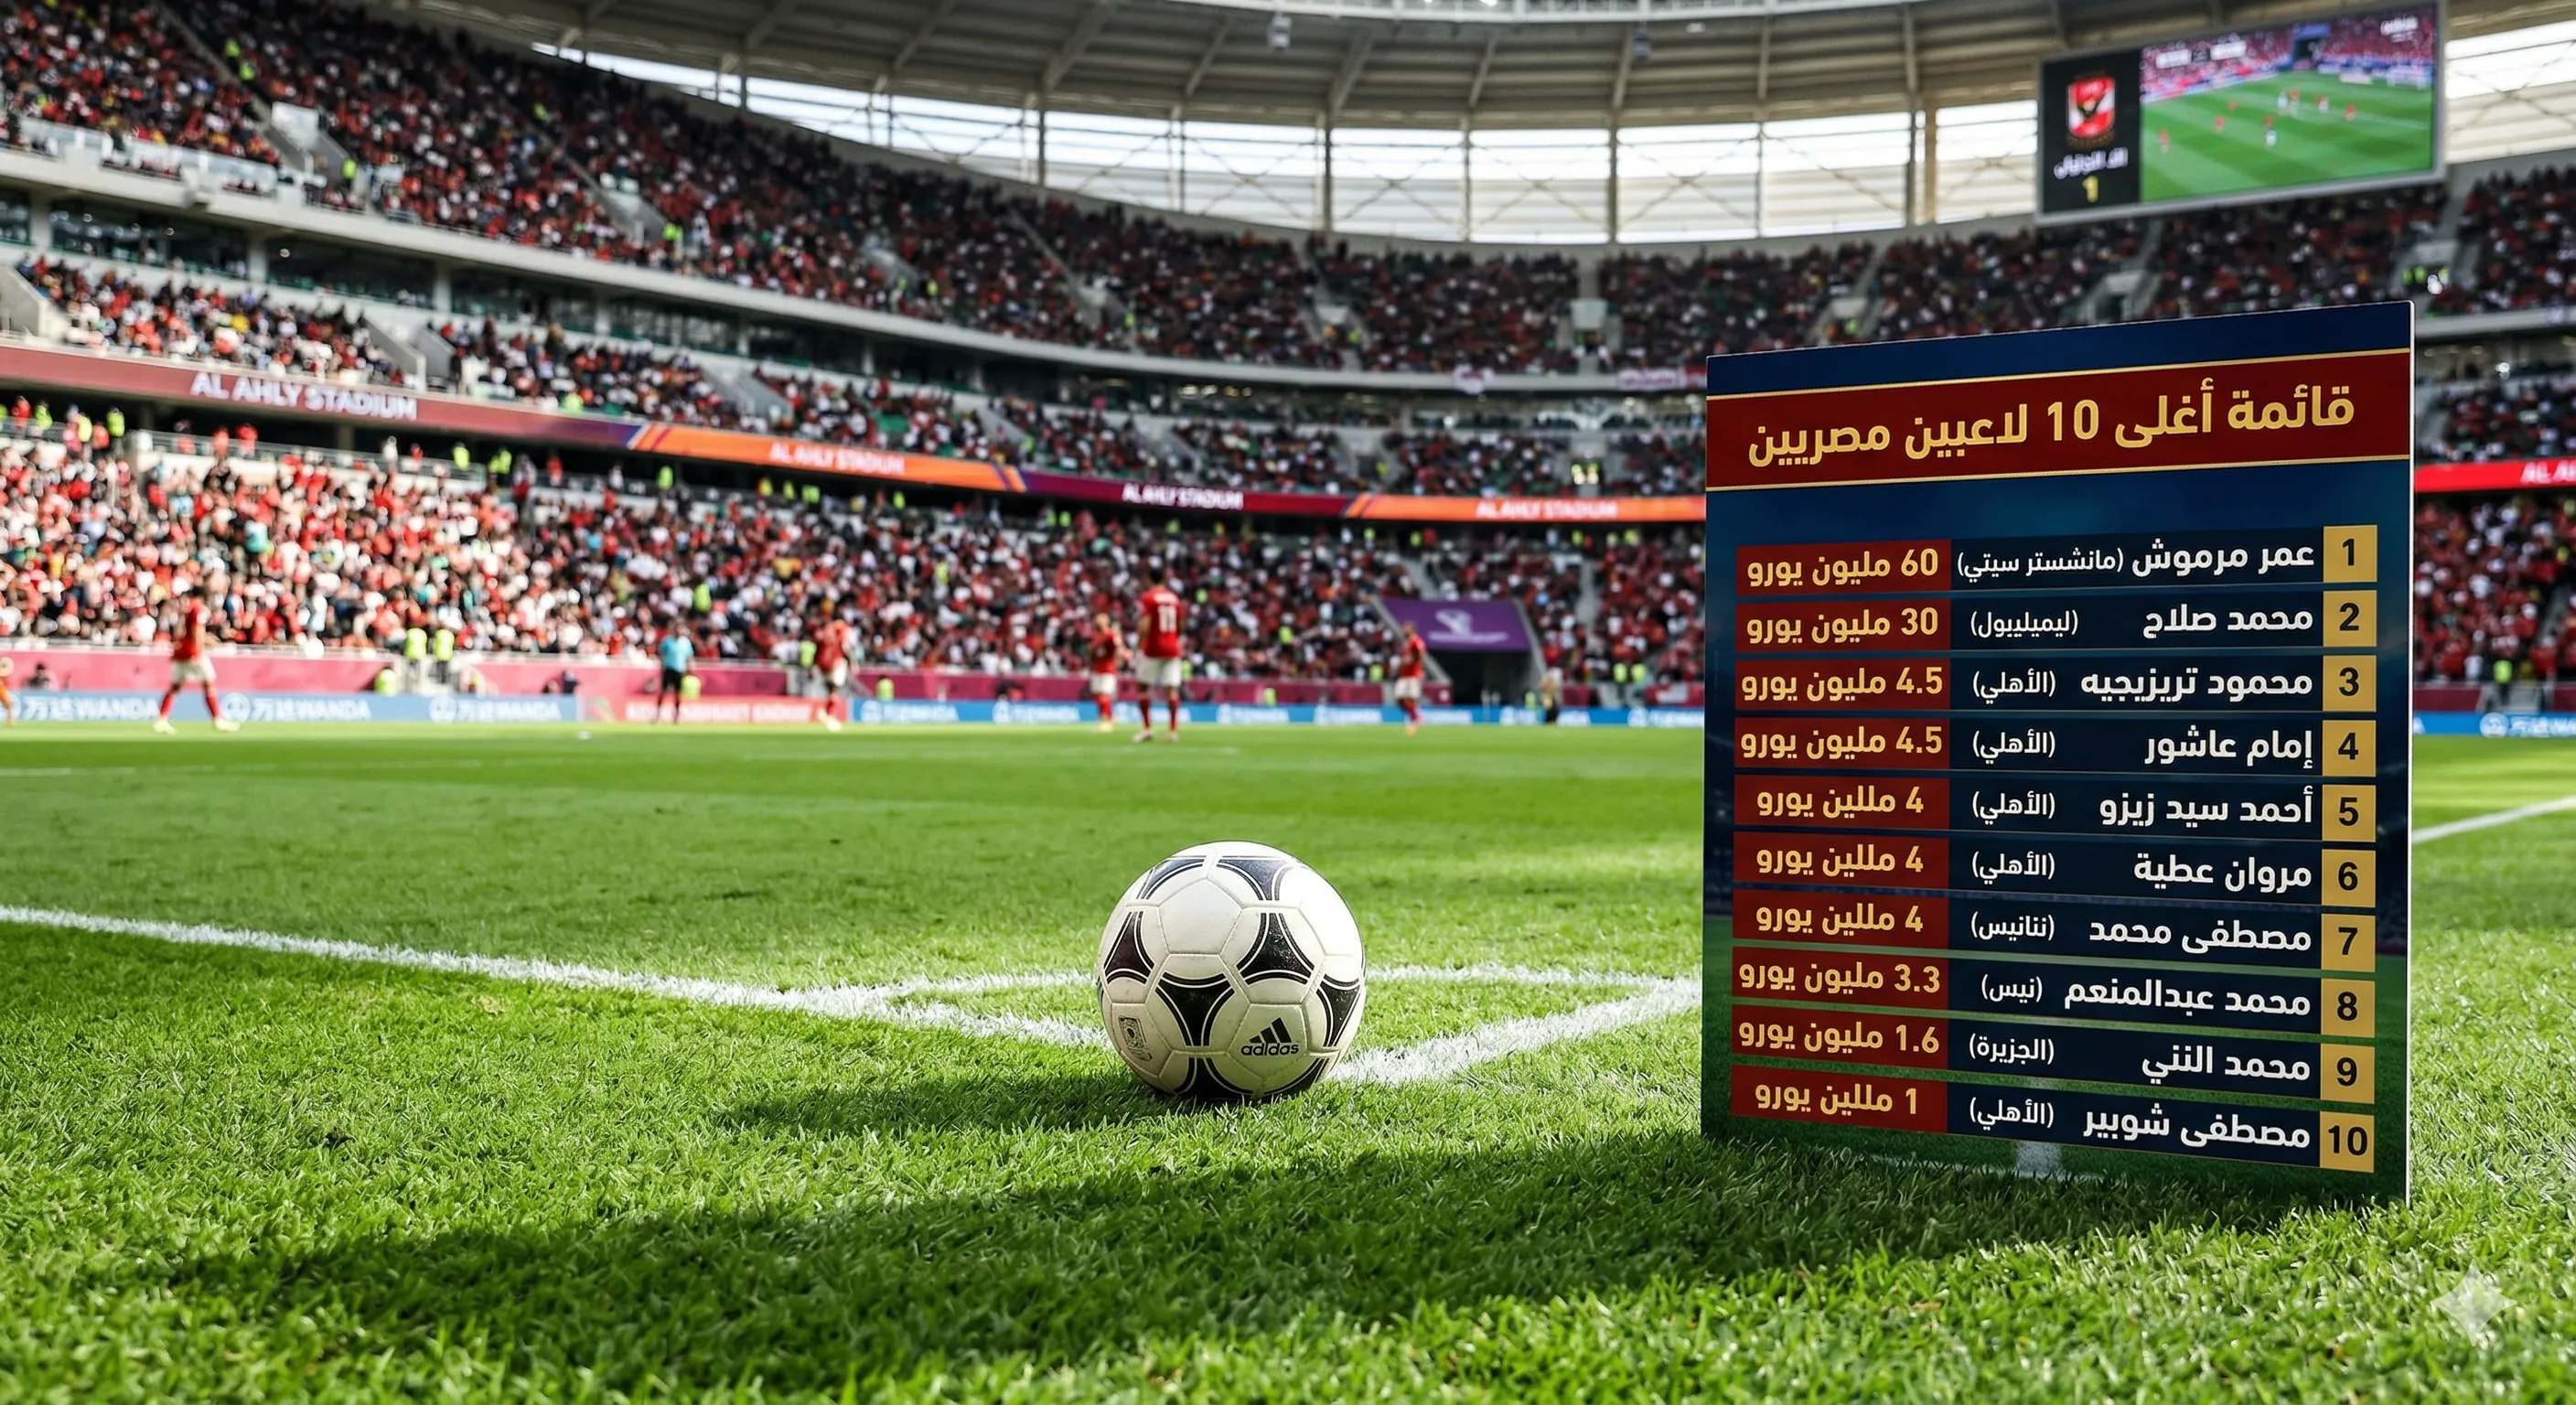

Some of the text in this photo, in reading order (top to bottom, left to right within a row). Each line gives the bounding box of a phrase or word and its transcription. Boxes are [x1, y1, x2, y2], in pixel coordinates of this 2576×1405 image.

[189, 372, 417, 420] AL AHLY STADIUM
[1749, 378, 2354, 467] قائمة أغلى 10 لاعبين مصريين
[1748, 539, 2354, 586] 1 عمر مرموش (مانشستر سيتي) 60 مليون يورو
[1747, 617, 1802, 644] يورو
[1812, 609, 1890, 643] مليون
[1902, 607, 1937, 636] 30
[2143, 604, 2216, 638] صلاح
[2227, 611, 2313, 630] محمد
[2340, 603, 2359, 630] 2
[1742, 667, 2358, 703] 3 محمود تريزيجيه (الأهلي) 4.5 مليون يورو
[1741, 725, 2358, 768] 4 إمام عاشور (الأهلي) 4.5 مليون يورو
[1757, 790, 1813, 817] يورو
[1906, 787, 1923, 812] 4
[1973, 791, 2055, 824] (الأهلي)
[2100, 793, 2153, 826] زيزو
[2166, 801, 2227, 828] سيد
[2240, 786, 2313, 822] أحمد
[2339, 798, 2358, 826] 5
[1757, 849, 1813, 875] يورو
[1906, 846, 1923, 872] 4
[1972, 852, 2055, 885] (الأهلي)
[2134, 853, 2213, 889] عطية
[2226, 857, 2311, 893] مروان
[2338, 862, 2357, 890] 6
[1756, 906, 1812, 933] يورو
[1905, 906, 1923, 931] 4
[2090, 923, 2171, 944] محمد
[2182, 920, 2311, 953] مصطفى
[2339, 928, 2357, 955] 7
[1740, 961, 2357, 1021] 8 محمد عبدالمنعم (نيس) 3.3 مليون يورو
[1240, 1043, 1300, 1056] adidas
[1740, 1021, 2356, 1086] 9 محمد النني (الجزيرة) 1.6 مليون يورو
[1755, 1083, 1810, 1112] يورو
[1906, 1089, 1916, 1114] 1
[1970, 1098, 2054, 1131] (الأهلي)
[2084, 1103, 2169, 1141] شوبير
[2181, 1114, 2310, 1147] مصطفى
[2328, 1125, 2367, 1155] 10
